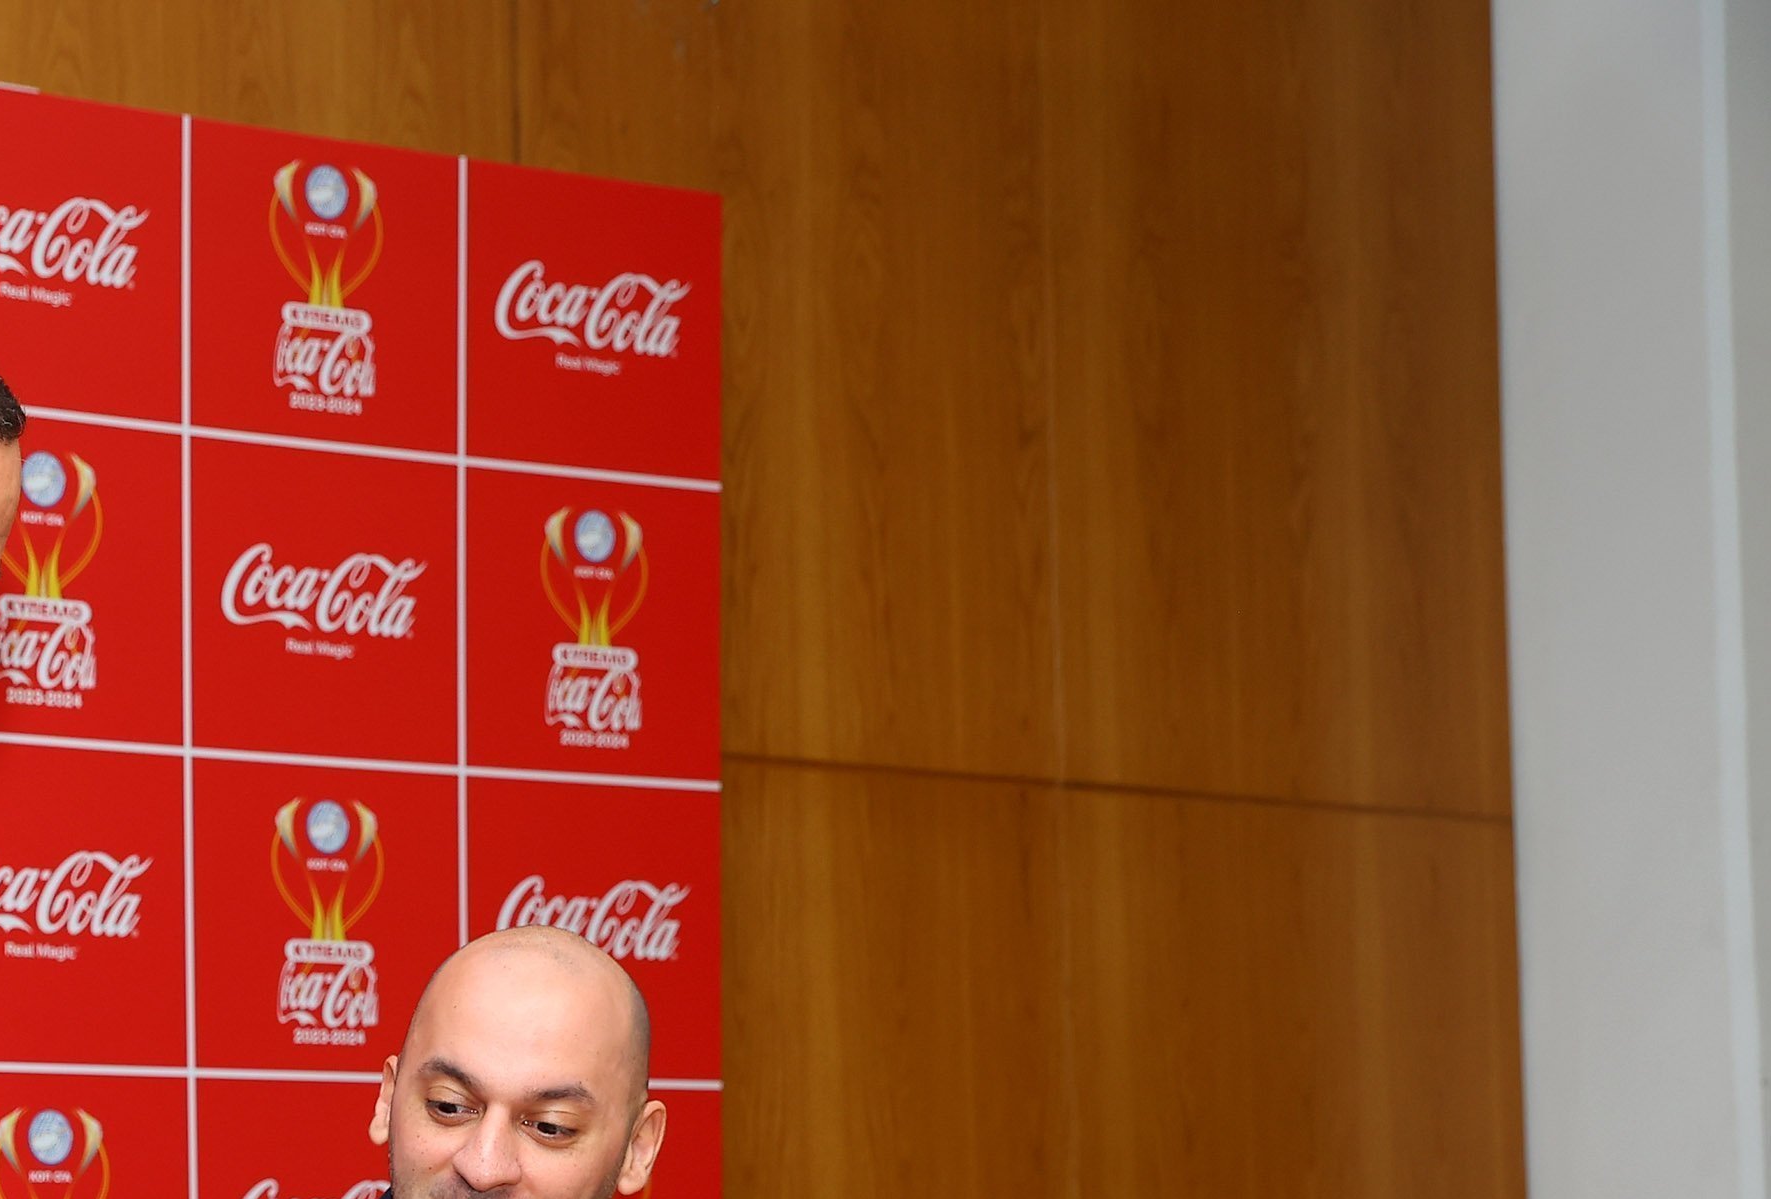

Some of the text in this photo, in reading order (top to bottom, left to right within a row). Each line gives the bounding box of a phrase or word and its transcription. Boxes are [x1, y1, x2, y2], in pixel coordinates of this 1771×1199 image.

[494, 260, 690, 358] Coca-Cola
[221, 543, 426, 638] Coca-Cola
[5, 942, 75, 961] Real Magic
